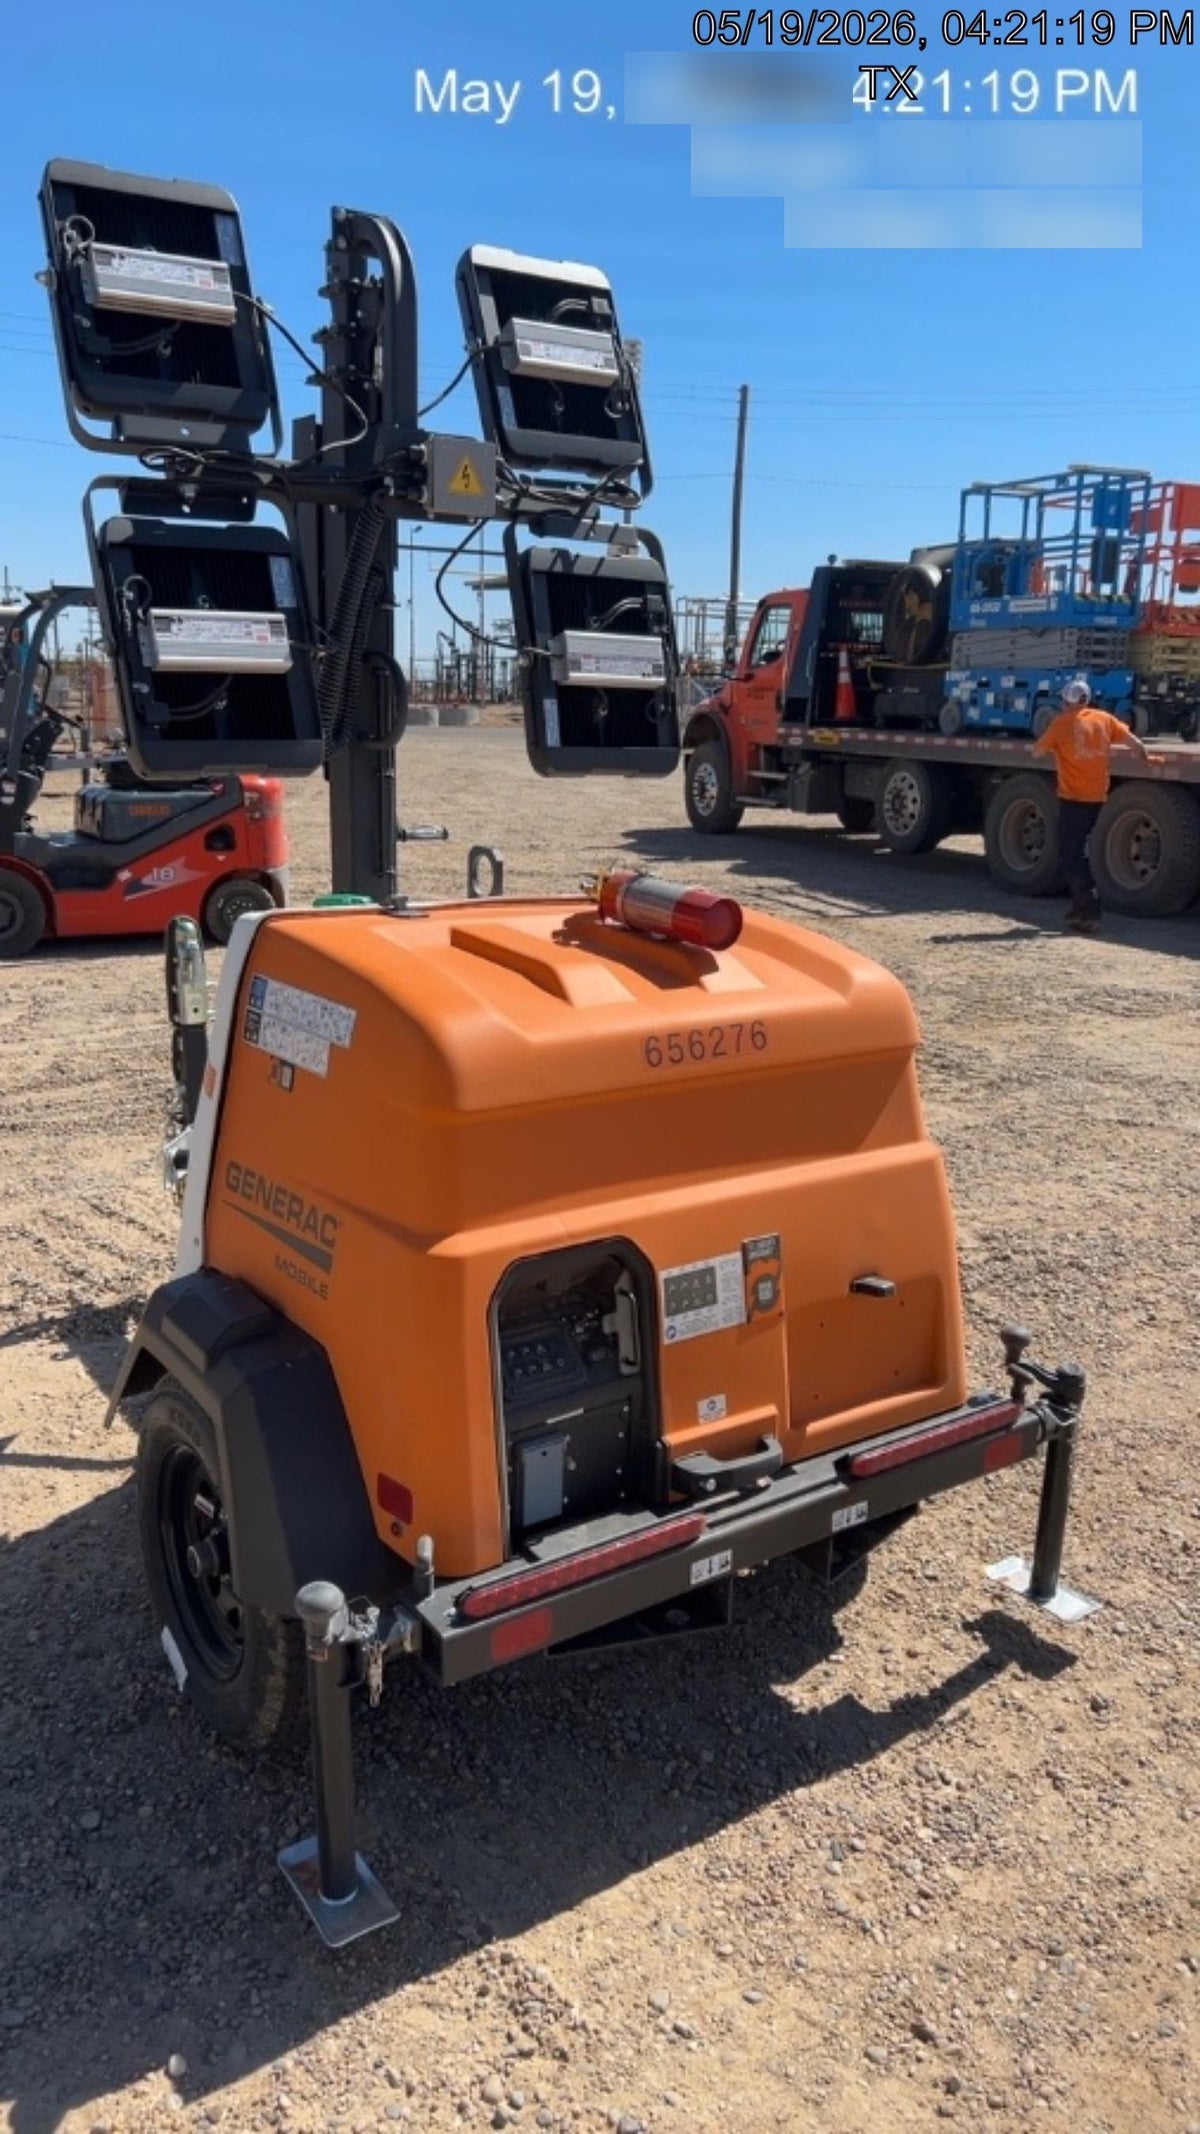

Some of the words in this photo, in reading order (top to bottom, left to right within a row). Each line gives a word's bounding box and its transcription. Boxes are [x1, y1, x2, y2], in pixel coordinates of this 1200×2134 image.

[645, 1020, 767, 1068] 656276
[225, 1160, 339, 1249] GENERAC
[273, 1254, 329, 1301] MOBILE
